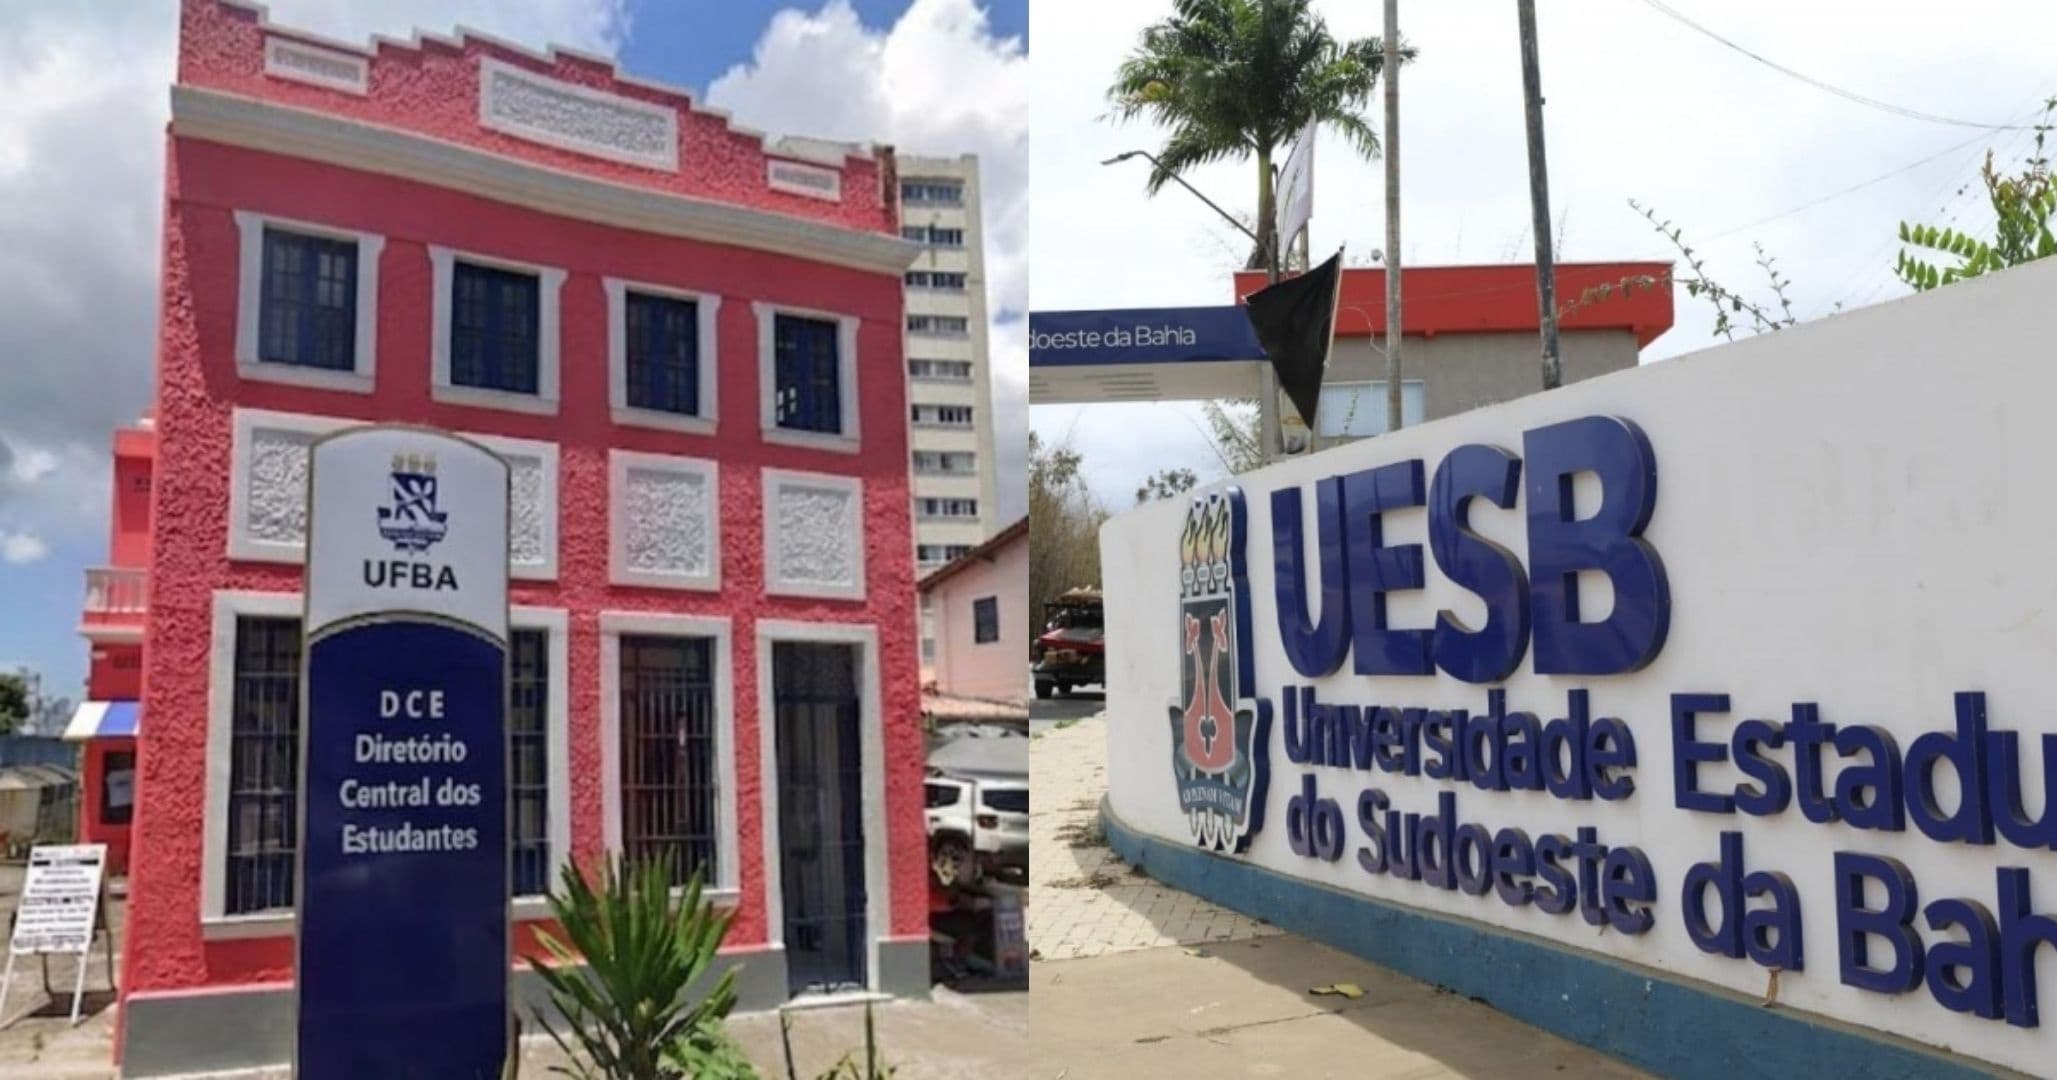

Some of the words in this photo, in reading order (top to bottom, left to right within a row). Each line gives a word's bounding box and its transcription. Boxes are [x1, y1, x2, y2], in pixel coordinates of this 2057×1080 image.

[1103, 325, 1132, 348] da
[1135, 324, 1196, 346] Bahia
[1270, 415, 1672, 684] UESB
[363, 559, 459, 591] UFBA
[355, 732, 467, 763] Diretório
[1282, 685, 1638, 801] Universidade
[1670, 691, 2057, 852] Estadu
[339, 777, 429, 808] Central
[437, 778, 480, 805] dos
[342, 822, 479, 854] Estudantes
[1286, 773, 1346, 862] do
[1357, 788, 1658, 936] Sudoeste
[1682, 831, 1804, 972] da
[1834, 851, 2057, 1028] Bah
